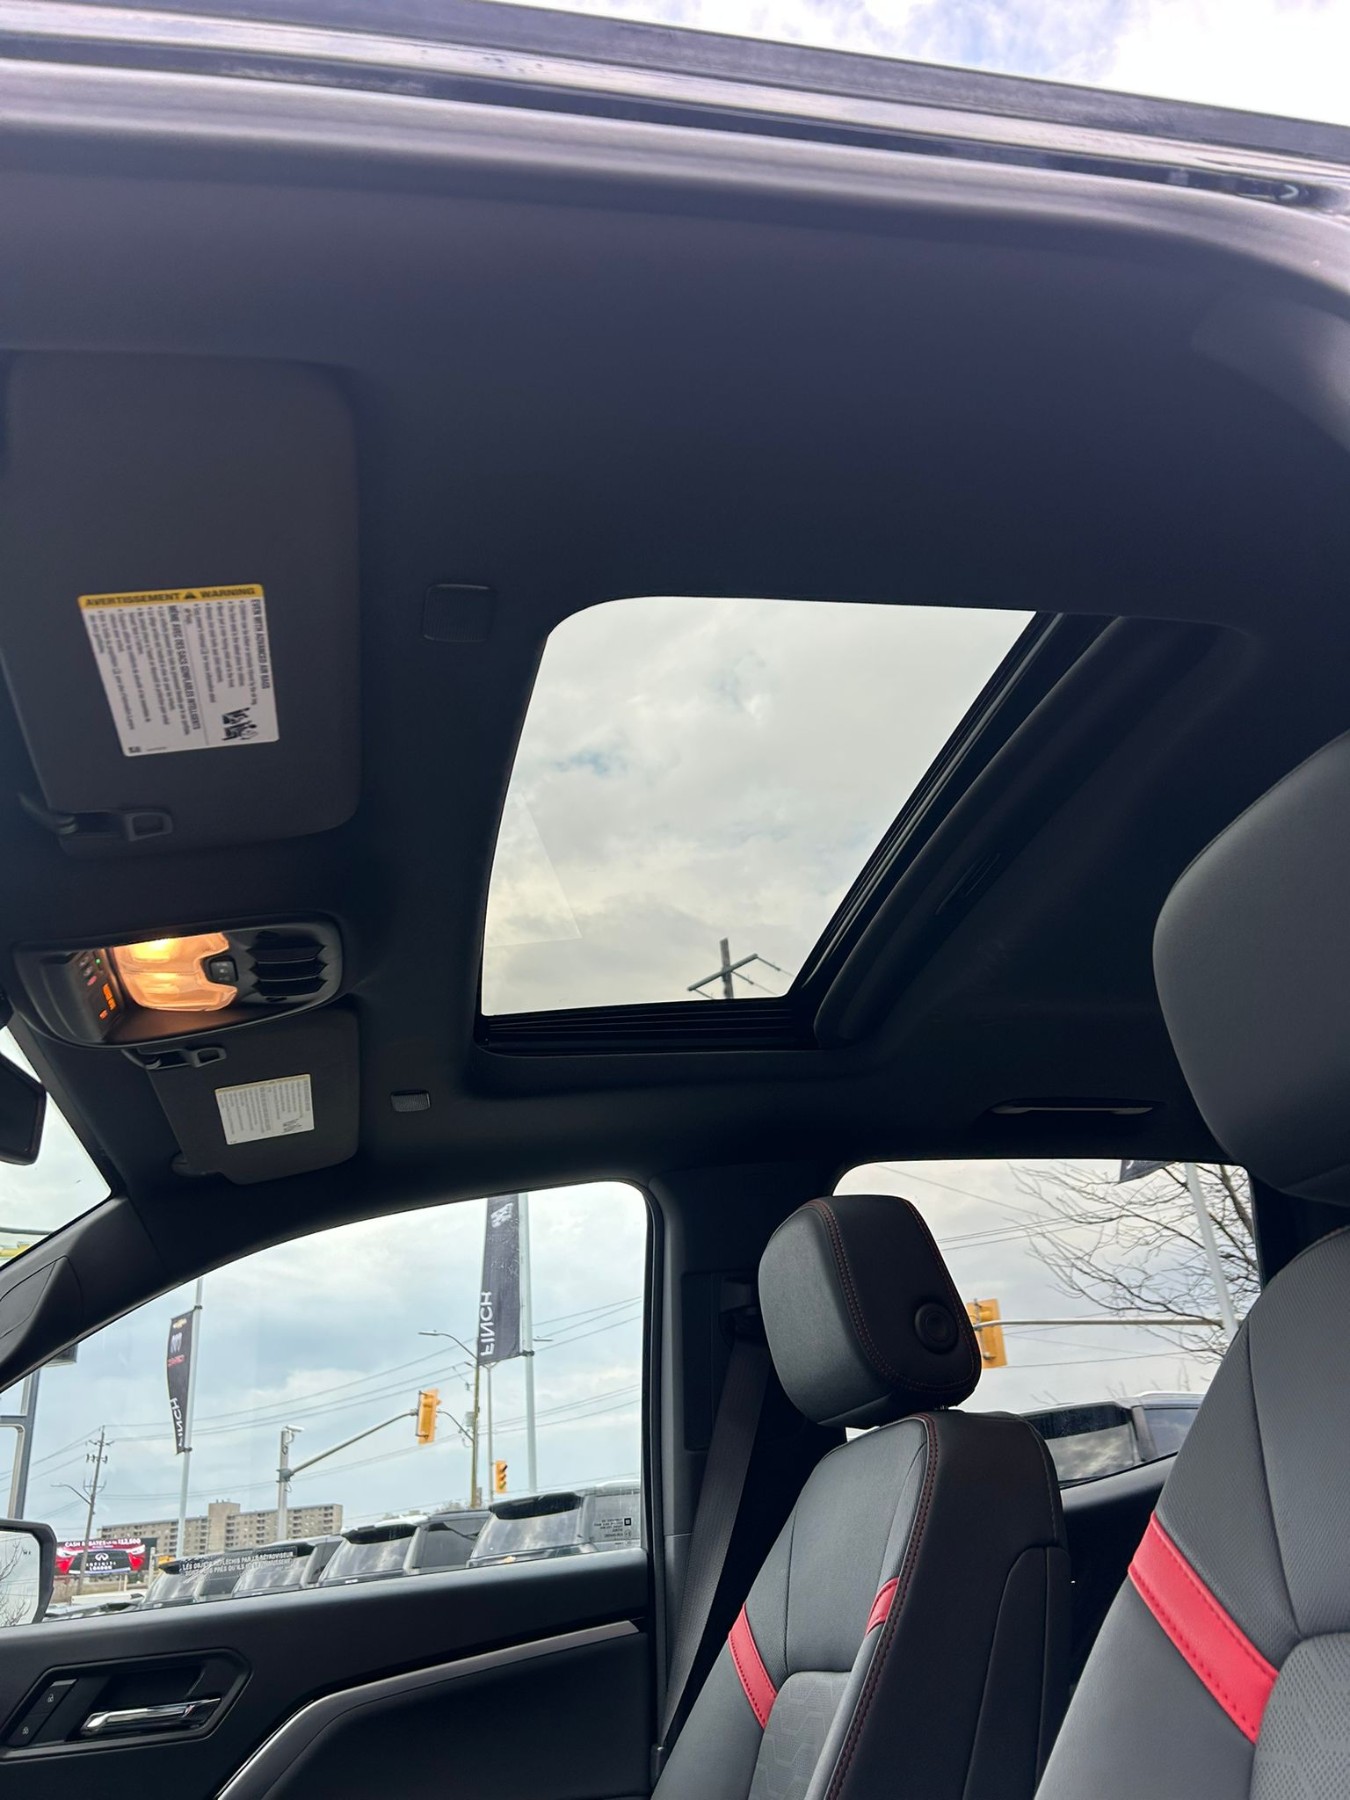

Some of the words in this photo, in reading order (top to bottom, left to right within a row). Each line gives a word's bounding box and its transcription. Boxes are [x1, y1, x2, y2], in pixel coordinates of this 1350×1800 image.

[86, 592, 180, 606] AVERTISSEMENT
[200, 588, 256, 598] WARNING
[251, 599, 261, 615] EVEN
[171, 623, 183, 637] AVEC
[253, 616, 263, 632] WITH
[174, 638, 185, 649] DES
[255, 633, 266, 663] ADVANCED
[176, 650, 188, 664] SACS
[259, 664, 267, 673] AIR
[260, 674, 269, 689] BAGS
